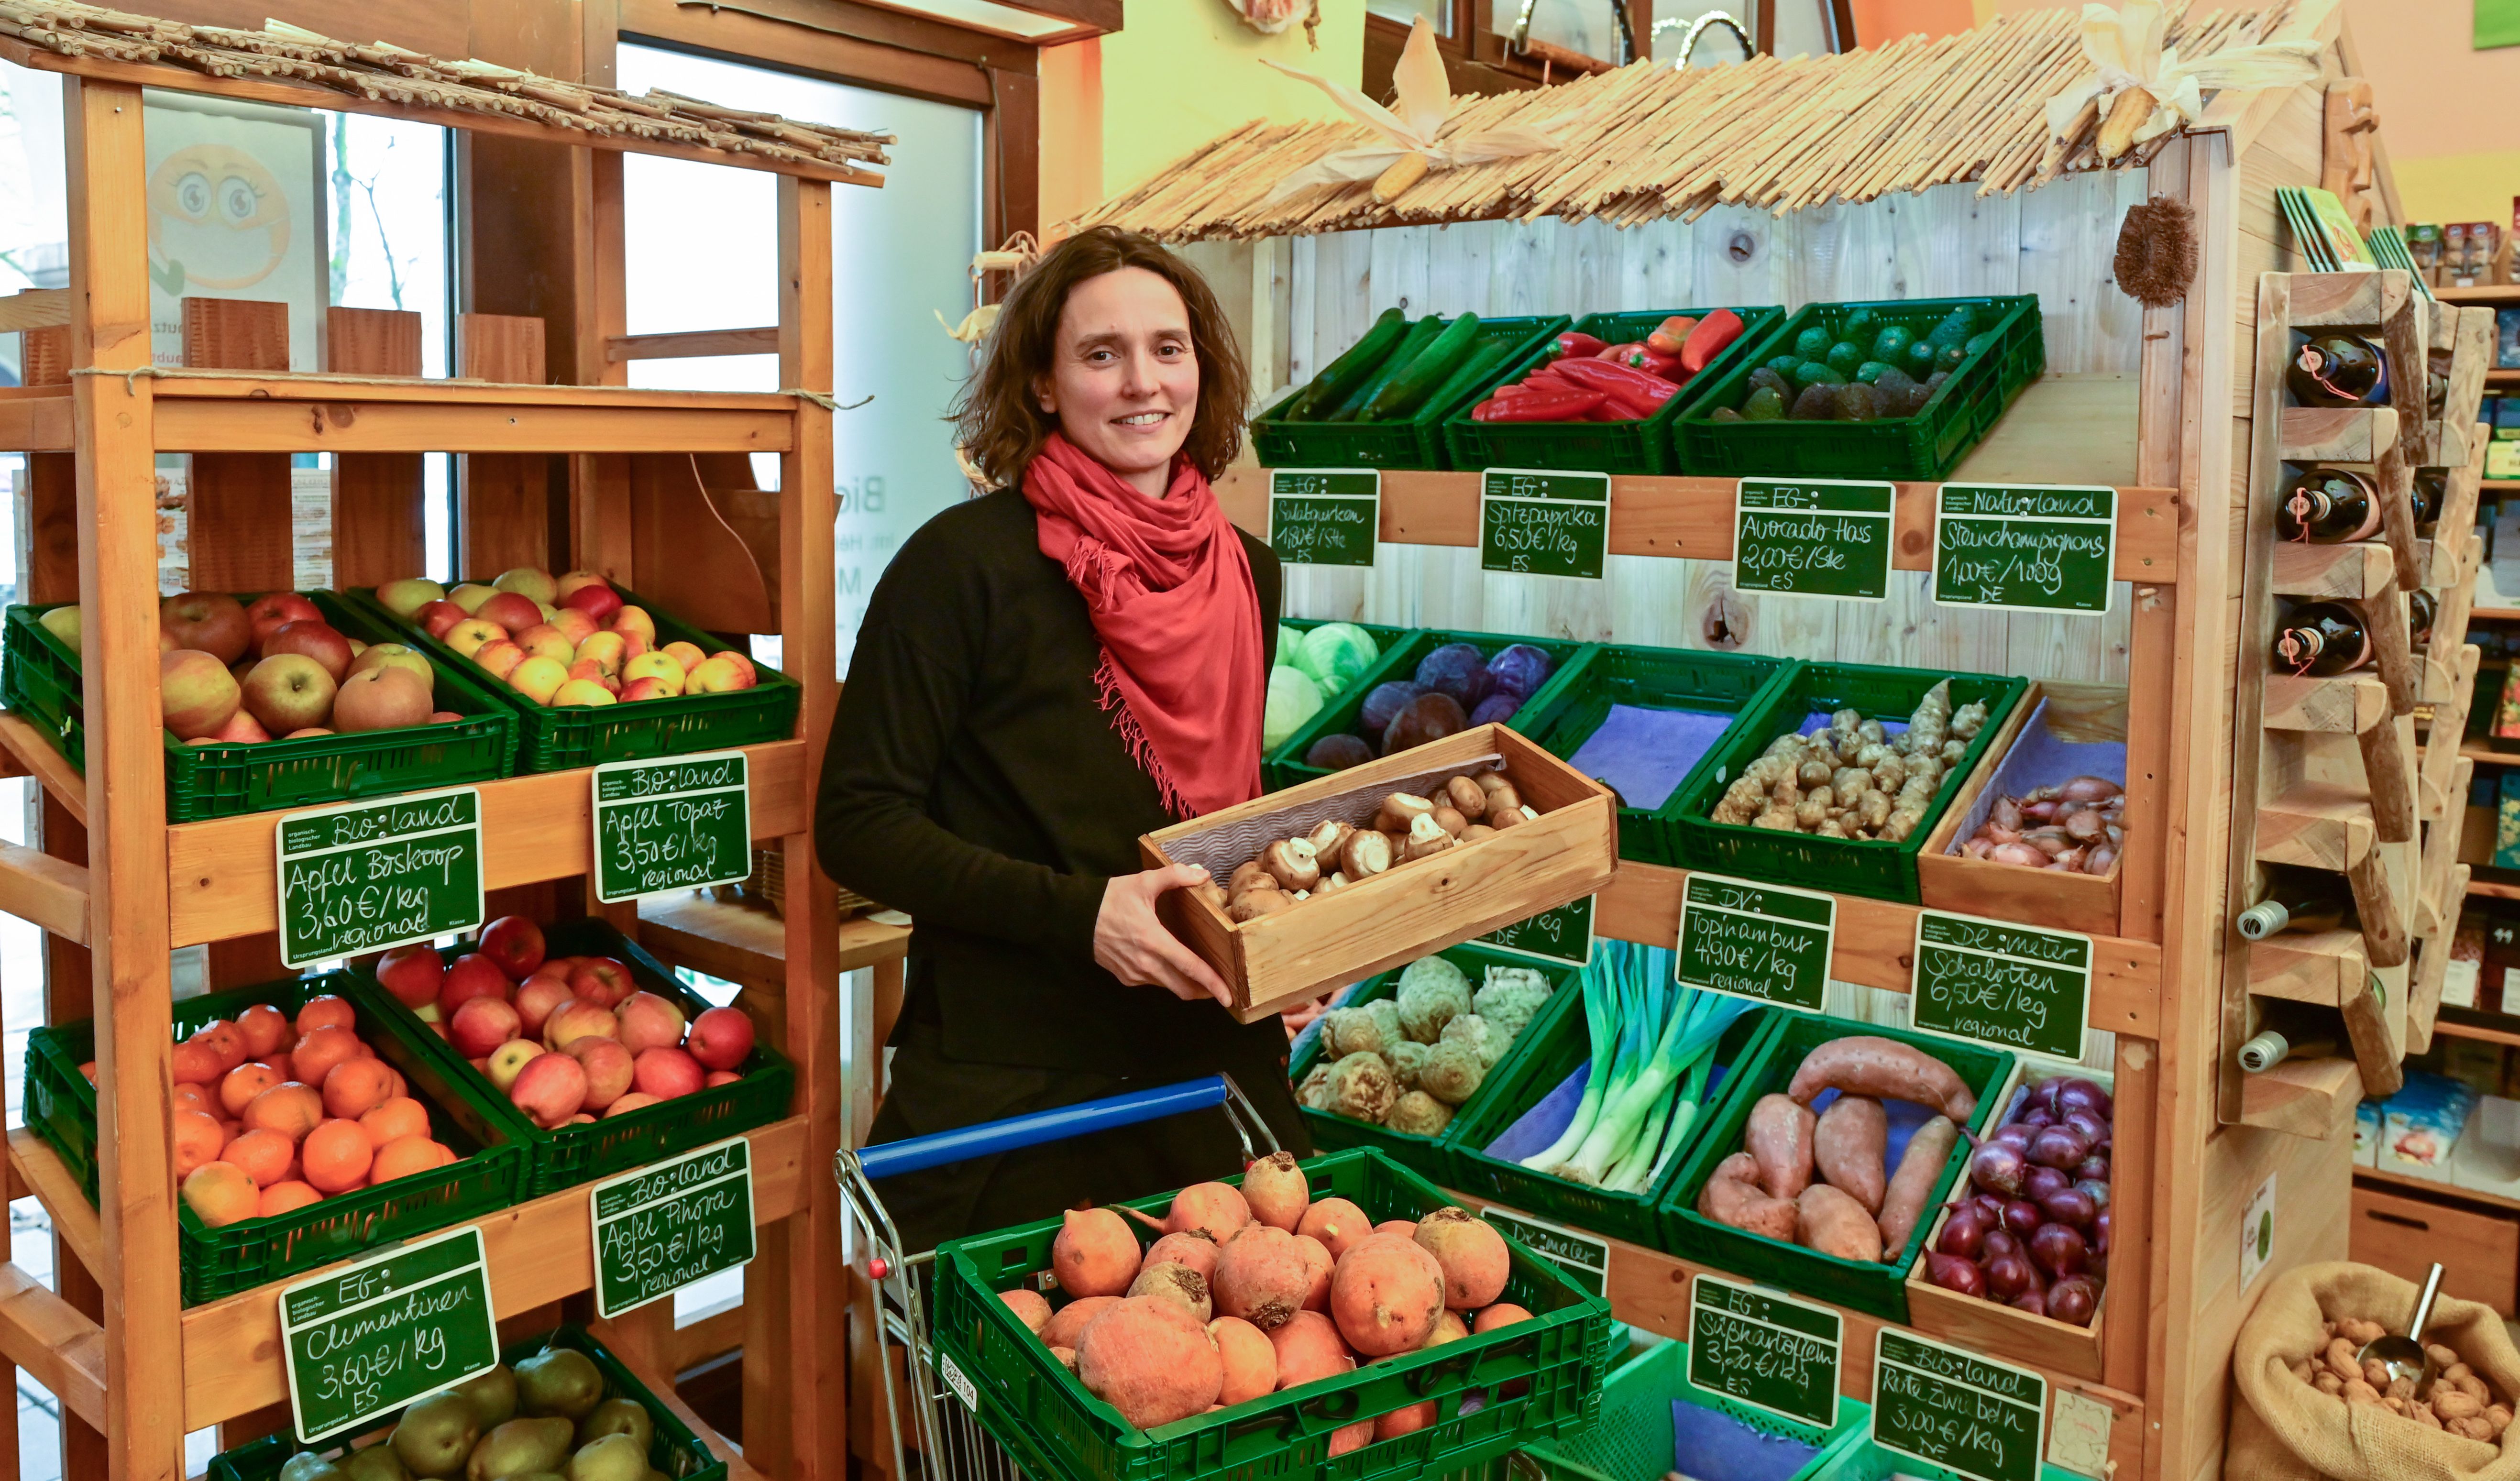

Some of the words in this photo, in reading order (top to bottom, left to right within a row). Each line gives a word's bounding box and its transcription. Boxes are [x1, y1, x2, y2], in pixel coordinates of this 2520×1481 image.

[1511, 476, 1538, 497] EG
[1773, 487, 1808, 508] EG
[1487, 502, 1599, 536] Spitzpaprika
[1741, 515, 1830, 542] Avocado
[1833, 517, 1872, 543] Hass
[1940, 520, 2105, 566] Steinchampignons
[1511, 555, 1530, 572] ES
[1771, 571, 1794, 590] ES
[1978, 584, 2004, 603] DE
[287, 828, 317, 837] organisch-
[606, 803, 662, 843] Apfel
[666, 798, 731, 838] Topaz
[288, 834, 320, 844] biologischer
[288, 842, 311, 850] Landbau
[286, 856, 357, 903] Apfel
[366, 841, 463, 885] Boskoop
[642, 856, 715, 890] regional
[332, 912, 429, 950] regional
[449, 918, 465, 926] Klasse
[1688, 911, 1812, 954] Topinambur
[1496, 929, 1519, 945] DE
[293, 946, 332, 960] Ursprungsland
[1925, 950, 2059, 994] Schalotten
[1710, 972, 1772, 999] regional
[1953, 1017, 2035, 1045] regional
[604, 1212, 659, 1260] Apfel
[339, 1269, 378, 1304] EG
[641, 1253, 710, 1298] regional
[292, 1295, 319, 1309] organisch-
[292, 1300, 324, 1315] biologischer
[1728, 1288, 1755, 1315] EG
[293, 1310, 316, 1322] Landbau
[307, 1285, 473, 1360] Clementinen
[963, 1382, 974, 1401] 104
[1727, 1377, 1751, 1395] ES
[354, 1382, 381, 1415] ES
[308, 1413, 348, 1434] Ursprungsland
